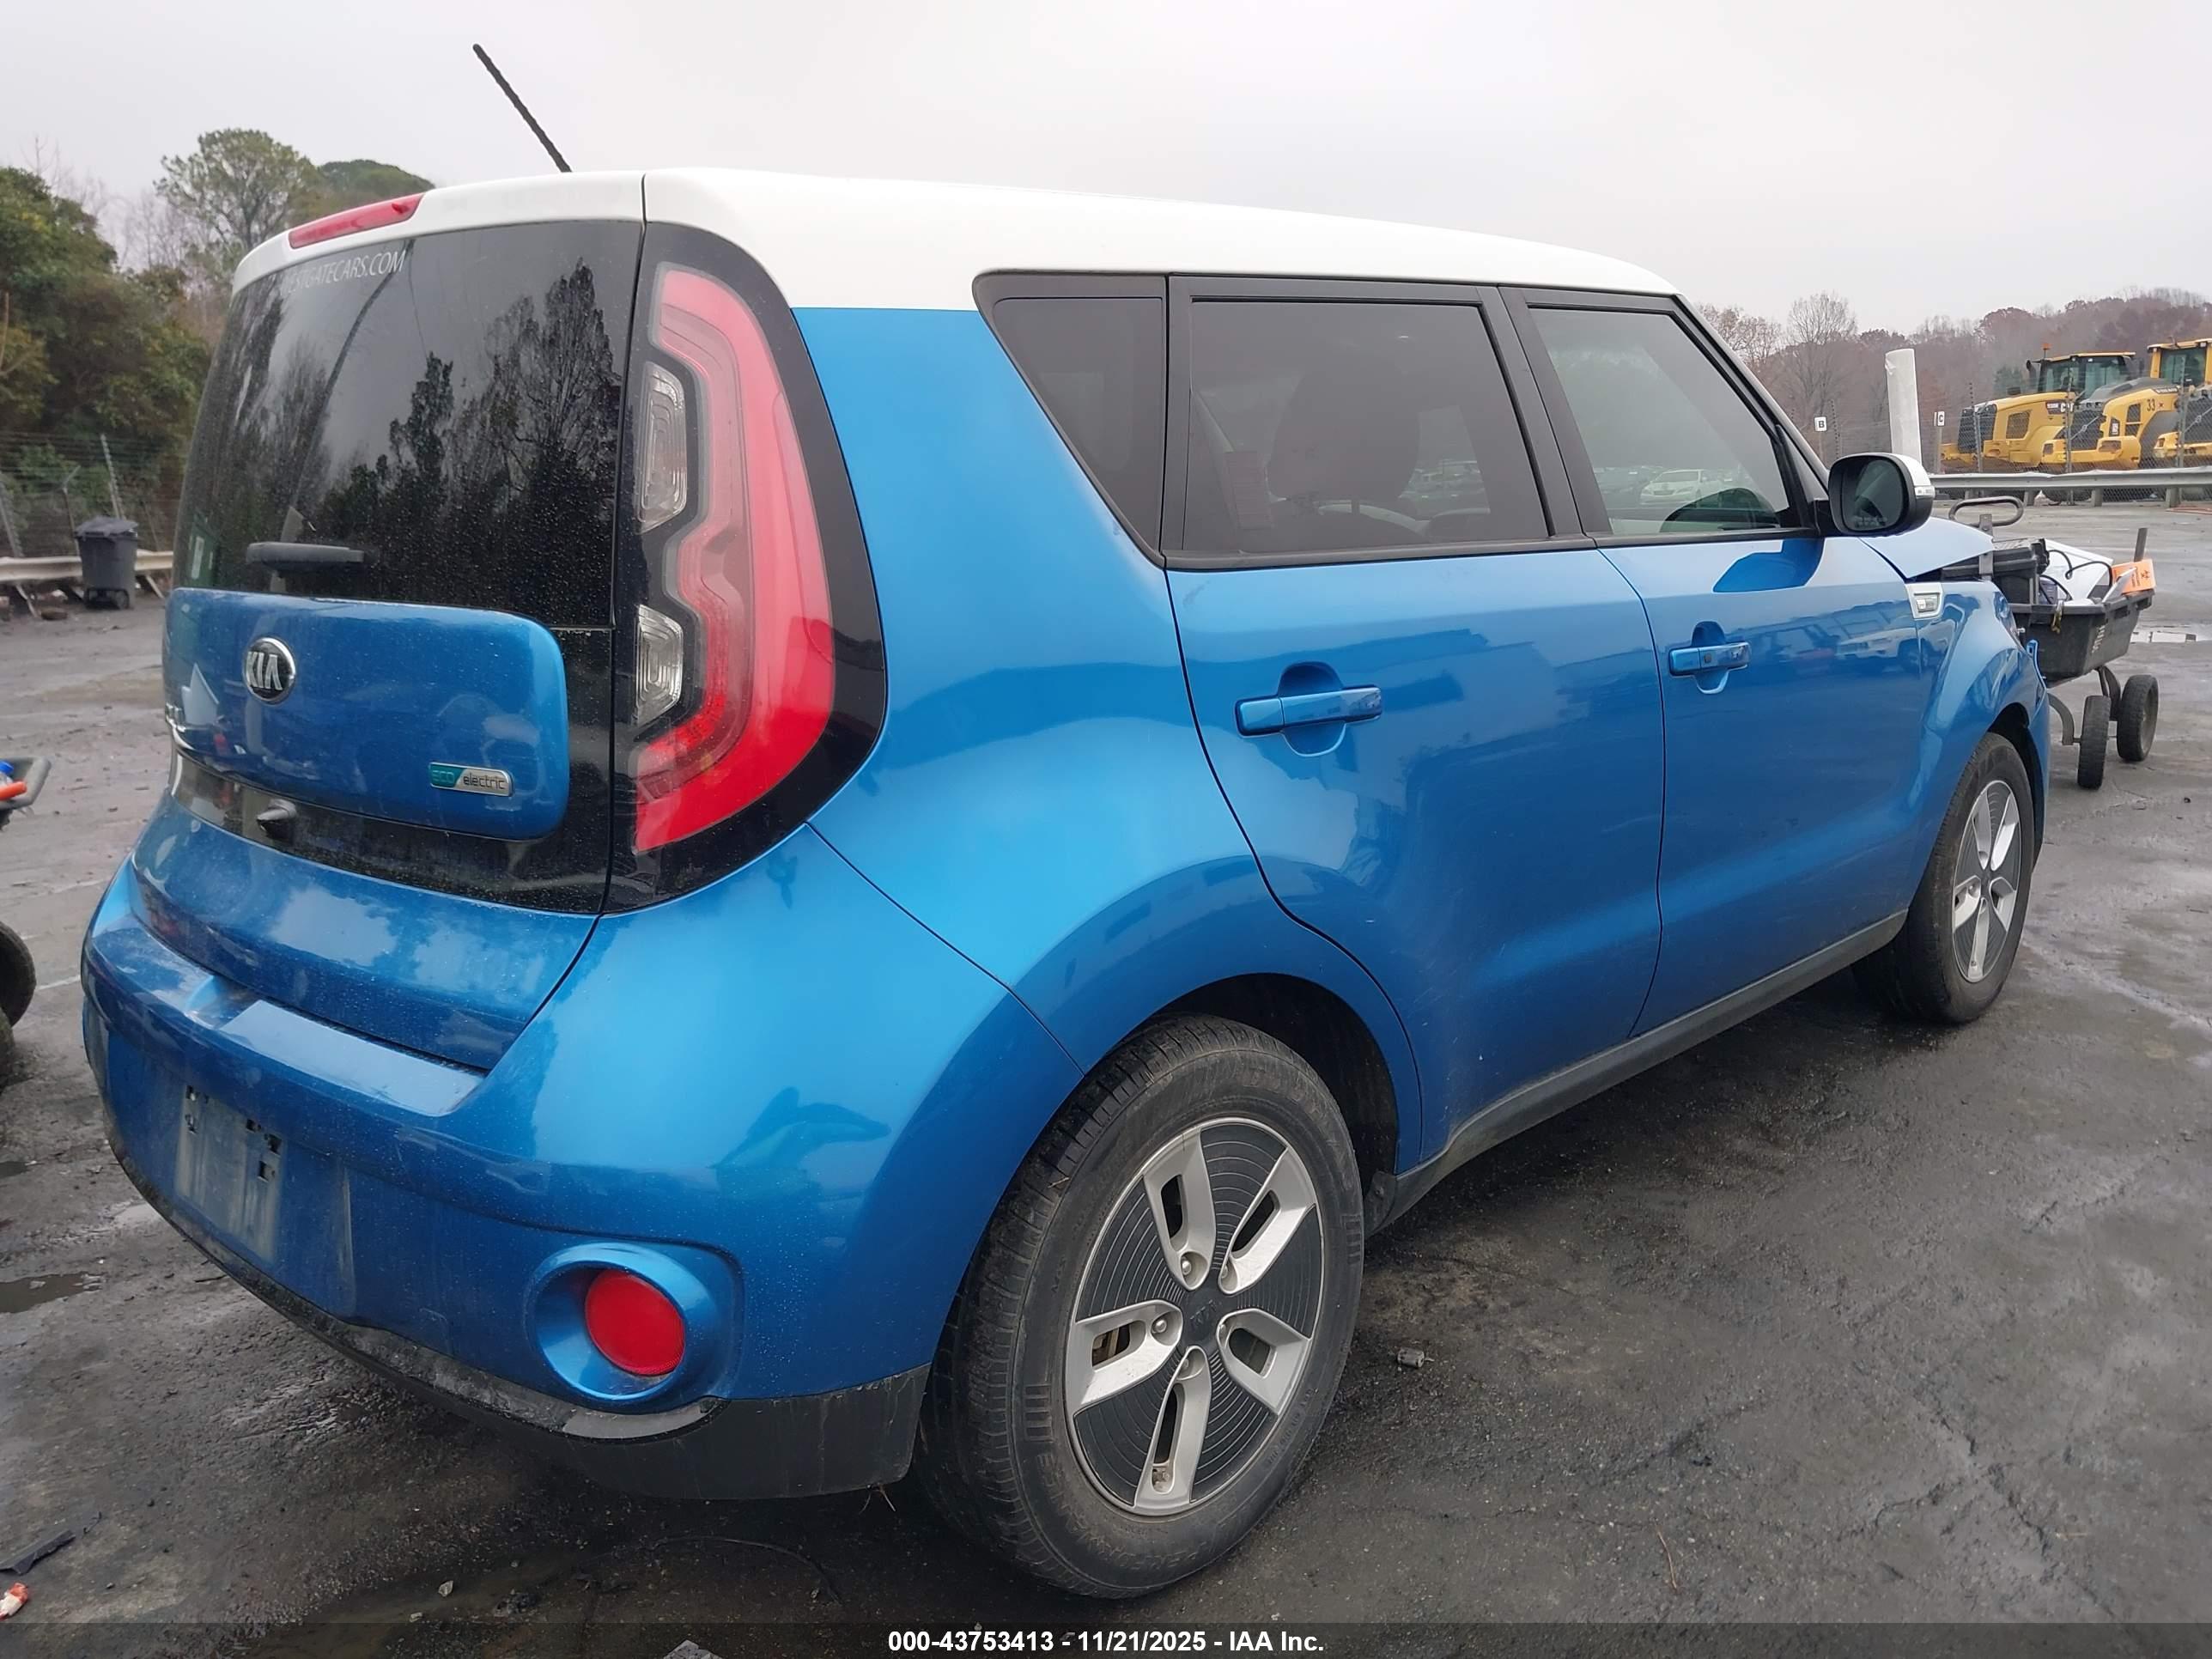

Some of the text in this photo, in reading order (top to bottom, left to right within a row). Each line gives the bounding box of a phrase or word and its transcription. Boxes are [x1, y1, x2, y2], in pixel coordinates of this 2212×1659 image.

[2147, 398, 2155, 412] 33
[1938, 414, 1944, 422] C
[246, 651, 283, 690] KIA
[432, 769, 506, 790] ECO electric
